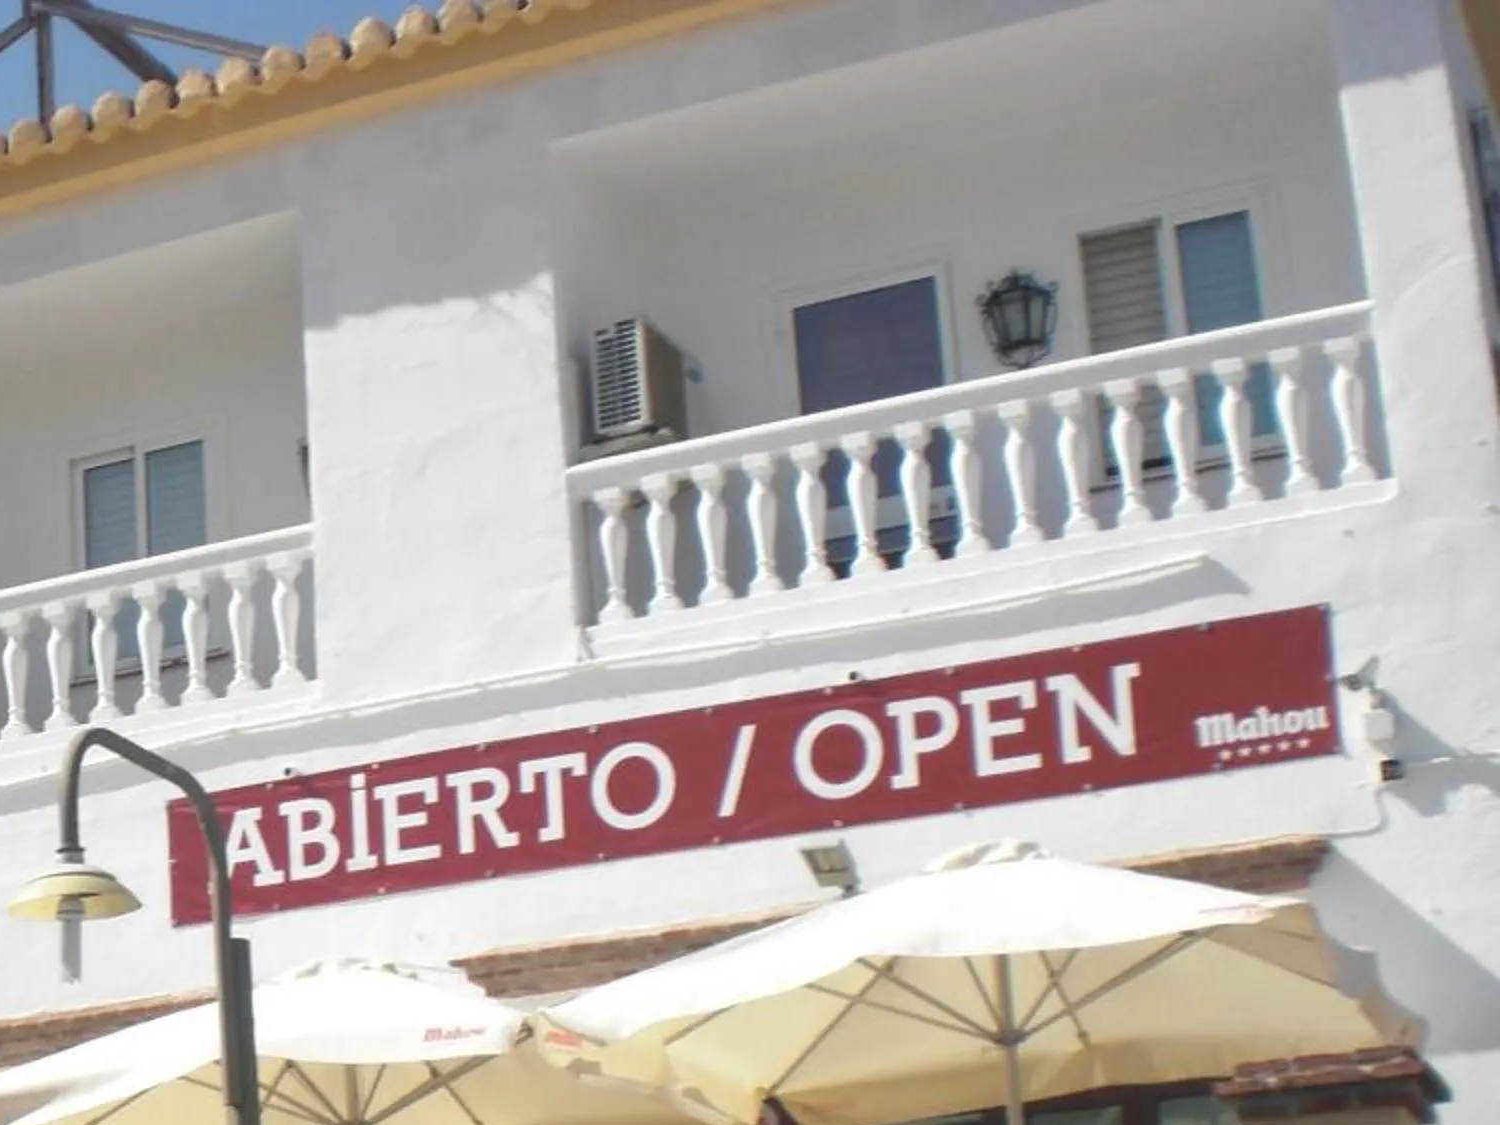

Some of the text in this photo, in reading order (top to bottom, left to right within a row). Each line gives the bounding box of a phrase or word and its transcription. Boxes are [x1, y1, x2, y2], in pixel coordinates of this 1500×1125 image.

[716, 724, 757, 818] /
[793, 662, 1141, 800] OPEN
[1195, 705, 1331, 748] Mahou
